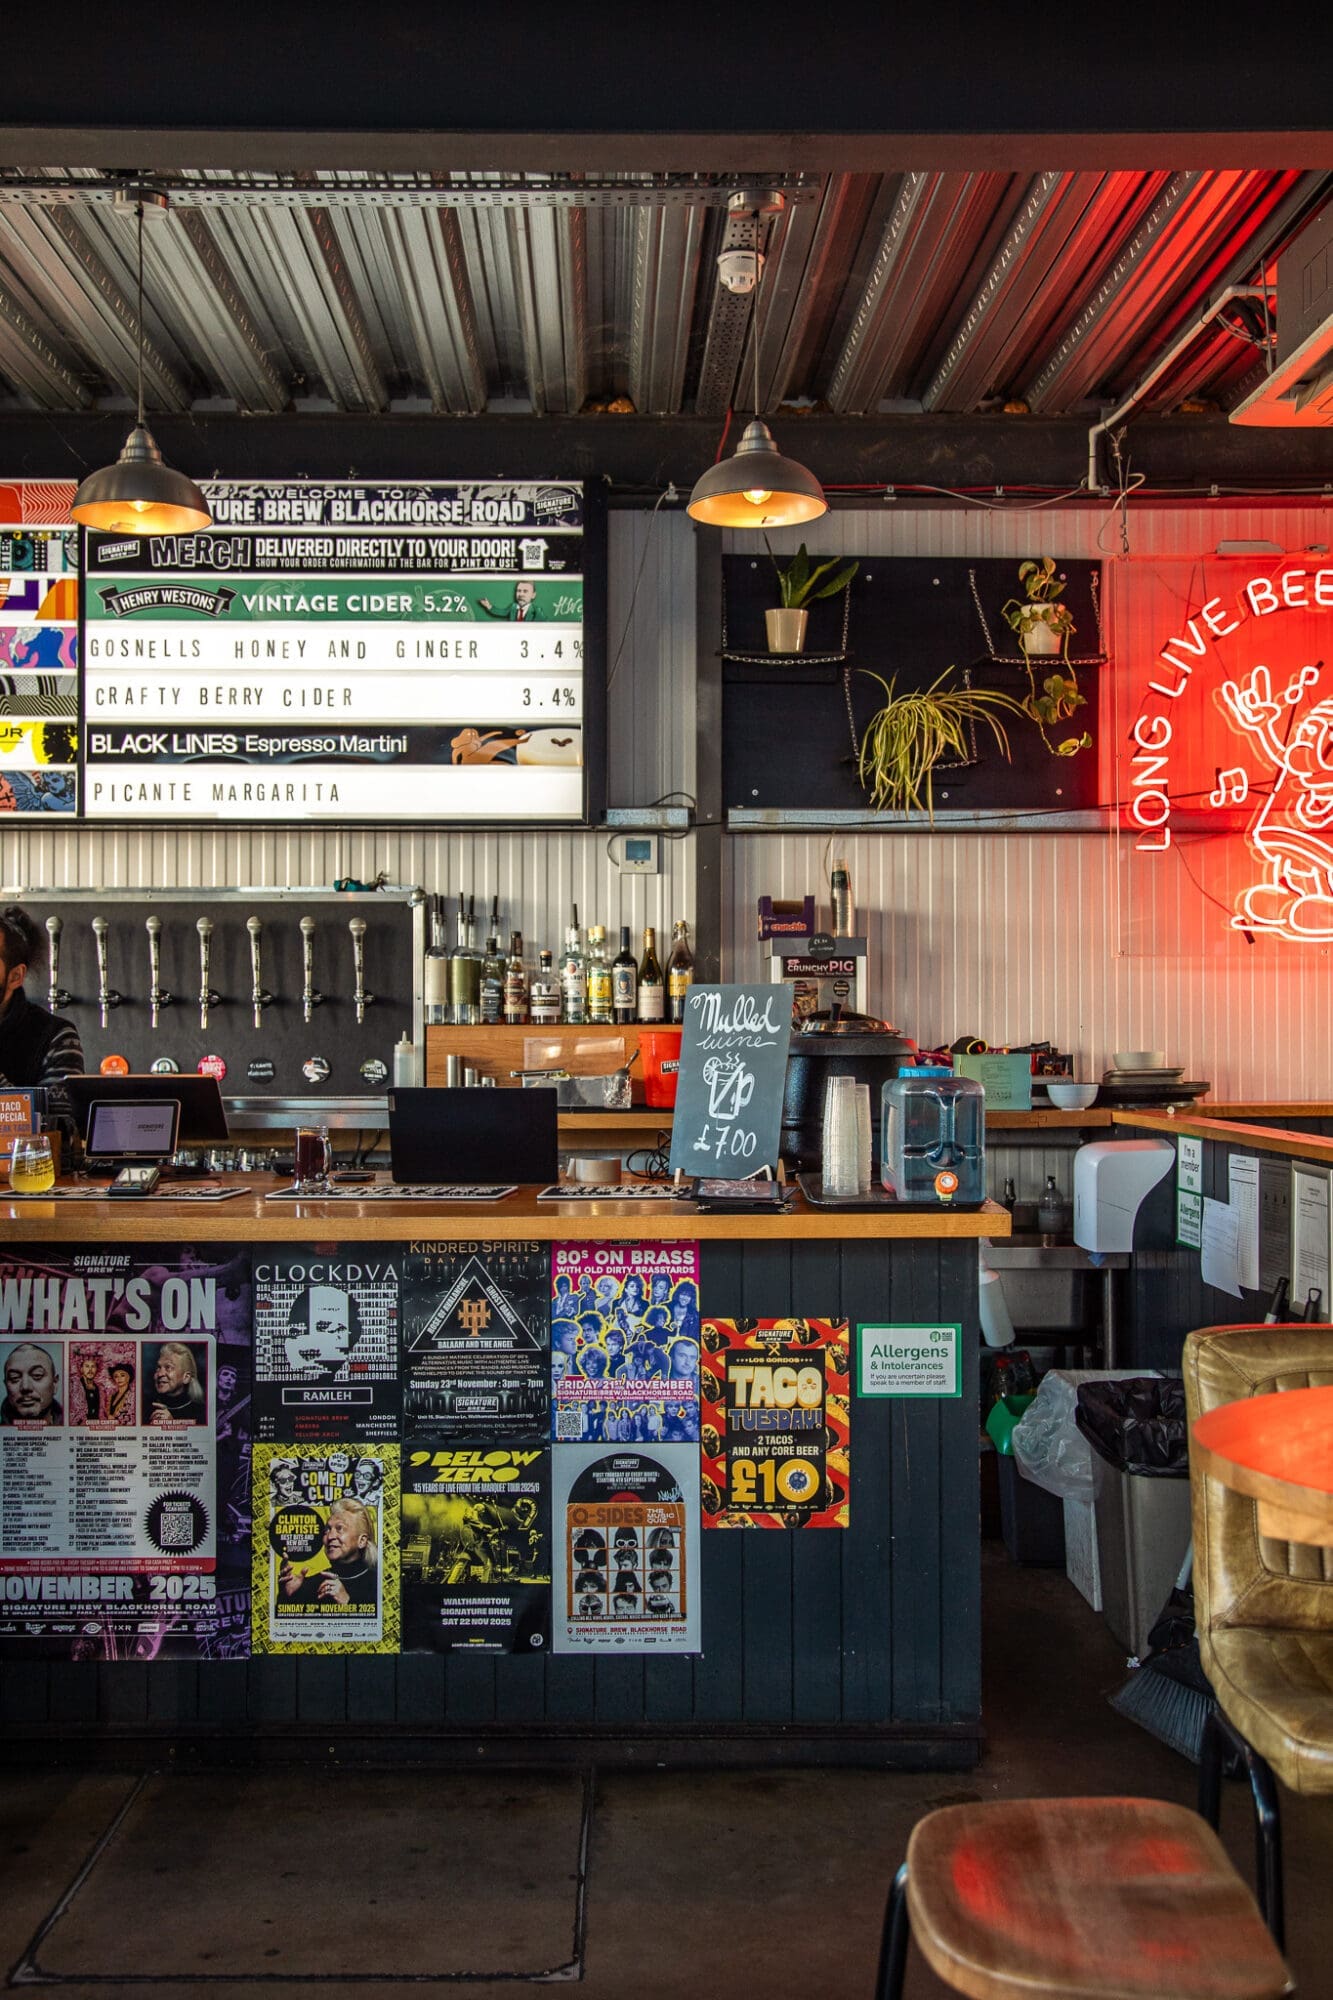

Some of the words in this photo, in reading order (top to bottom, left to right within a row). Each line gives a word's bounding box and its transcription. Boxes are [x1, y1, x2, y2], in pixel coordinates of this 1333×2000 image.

[267, 489, 366, 499] WELCOME
[377, 489, 403, 499] TO
[263, 500, 323, 521] BREW
[331, 500, 463, 522] BLACKHORSE
[471, 500, 526, 522] ROAD
[150, 534, 251, 570] MERCH
[255, 538, 334, 557] DELIVERED
[336, 538, 405, 557] DIRECTLY
[406, 538, 426, 557] TO
[428, 538, 468, 557] YOUR
[471, 538, 516, 558] DOOR!
[255, 558, 277, 568] SHOW
[279, 558, 299, 568] YOUR
[302, 558, 327, 568] ORDER
[329, 558, 386, 568] CONFIRMATION
[388, 558, 397, 568] AT
[400, 558, 414, 568] THE
[416, 558, 431, 568] BAR
[434, 558, 449, 568] FOR
[451, 558, 457, 568] A
[460, 558, 480, 568] PINT
[483, 558, 495, 568] ON
[119, 590, 159, 611] HENRY
[161, 590, 216, 611] WESTONS
[241, 594, 339, 613] VINTAGE
[345, 594, 413, 613] CIDER
[422, 594, 468, 614] 5.2%
[90, 638, 201, 658] GOSNELLS
[234, 639, 306, 659] HONEY
[328, 639, 367, 660] AND
[396, 639, 479, 660] GINGER
[1147, 597, 1240, 698] LIVE
[95, 686, 181, 706] CRAFTY
[199, 686, 263, 706] BERRY
[282, 687, 353, 707] CIDER
[522, 688, 576, 707] 3.4%
[91, 734, 169, 754] BLACK
[172, 734, 238, 754] LINES
[245, 735, 336, 756] Espresso
[339, 734, 408, 754] Martini
[1132, 714, 1173, 851] LONG
[94, 783, 192, 802] PICANTE
[212, 783, 340, 802] MARGARITA
[787, 964, 829, 972] CRUNCHY
[829, 960, 854, 972] PIG
[690, 992, 781, 1034] Mulled
[696, 1034, 777, 1050] wine
[1, 1101, 21, 1112] TACO
[693, 1123, 757, 1159] £7.00
[410, 1241, 478, 1254] KINDRED
[482, 1240, 540, 1253] SPIRITS
[73, 1256, 131, 1266] SIGNATURE
[487, 1256, 530, 1264] FEST
[594, 1250, 624, 1265] ON
[631, 1250, 695, 1265] BRASS
[255, 1264, 398, 1282] CLOCKDVA
[556, 1266, 582, 1274] WITH
[584, 1266, 603, 1274] OLD
[606, 1266, 633, 1274] DIRTY
[635, 1266, 695, 1274] BRASSTARDS
[0, 1277, 152, 1330] WHAT'S
[161, 1277, 216, 1330] ON
[485, 1284, 503, 1306] GHOST
[499, 1303, 518, 1326] DANCE
[757, 1330, 792, 1338] SIGNATURE
[437, 1341, 465, 1349] BALAAM
[465, 1341, 479, 1349] AND
[480, 1341, 492, 1349] THE
[493, 1340, 514, 1348] ANGEL
[870, 1344, 949, 1360] Allergens
[870, 1361, 878, 1370] &
[881, 1360, 944, 1370] Intolerances
[410, 1380, 440, 1389] Sunday
[457, 1380, 498, 1388] November
[502, 1379, 520, 1389] 3pm
[527, 1379, 544, 1389] 7pm
[557, 1380, 599, 1389] FRIDAY
[625, 1380, 694, 1389] NOVEMBER
[728, 1366, 823, 1408] TACO
[303, 1391, 352, 1401] RAMLEH
[457, 1398, 497, 1407] SIGNATURE
[728, 1408, 823, 1431] TUESDAY!
[757, 1435, 764, 1445] 2
[765, 1435, 793, 1445] TACOS
[409, 1450, 431, 1467] 9
[431, 1450, 543, 1467] BELOW
[732, 1446, 750, 1456] AND
[752, 1446, 769, 1456] ANY
[771, 1445, 795, 1456] CORE
[796, 1445, 819, 1456] BEER
[300, 1471, 353, 1487] COMEDY
[434, 1467, 520, 1483] ZERO
[731, 1458, 820, 1503] £10
[308, 1486, 343, 1502] CLUB
[278, 1514, 317, 1525] CLINTON
[572, 1507, 643, 1524] Q-SIDES
[275, 1524, 320, 1534] BAPTISTE
[150, 1576, 216, 1600] 2025
[2, 1603, 67, 1611] SIGNATURE
[70, 1603, 102, 1611] BREW
[106, 1603, 181, 1611] BLACKHORSE
[186, 1603, 216, 1611] ROAD
[278, 1604, 304, 1613] SUNDAY
[320, 1604, 357, 1613] NOVEMBER
[358, 1604, 376, 1613] 2025
[443, 1598, 510, 1606] WALTHAMSTOW
[441, 1607, 486, 1616] SIGNATURE
[488, 1607, 513, 1616] BREW
[442, 1618, 458, 1626] SAT
[460, 1618, 471, 1626] 22
[472, 1618, 489, 1626] NOV
[490, 1618, 512, 1626] 2025
